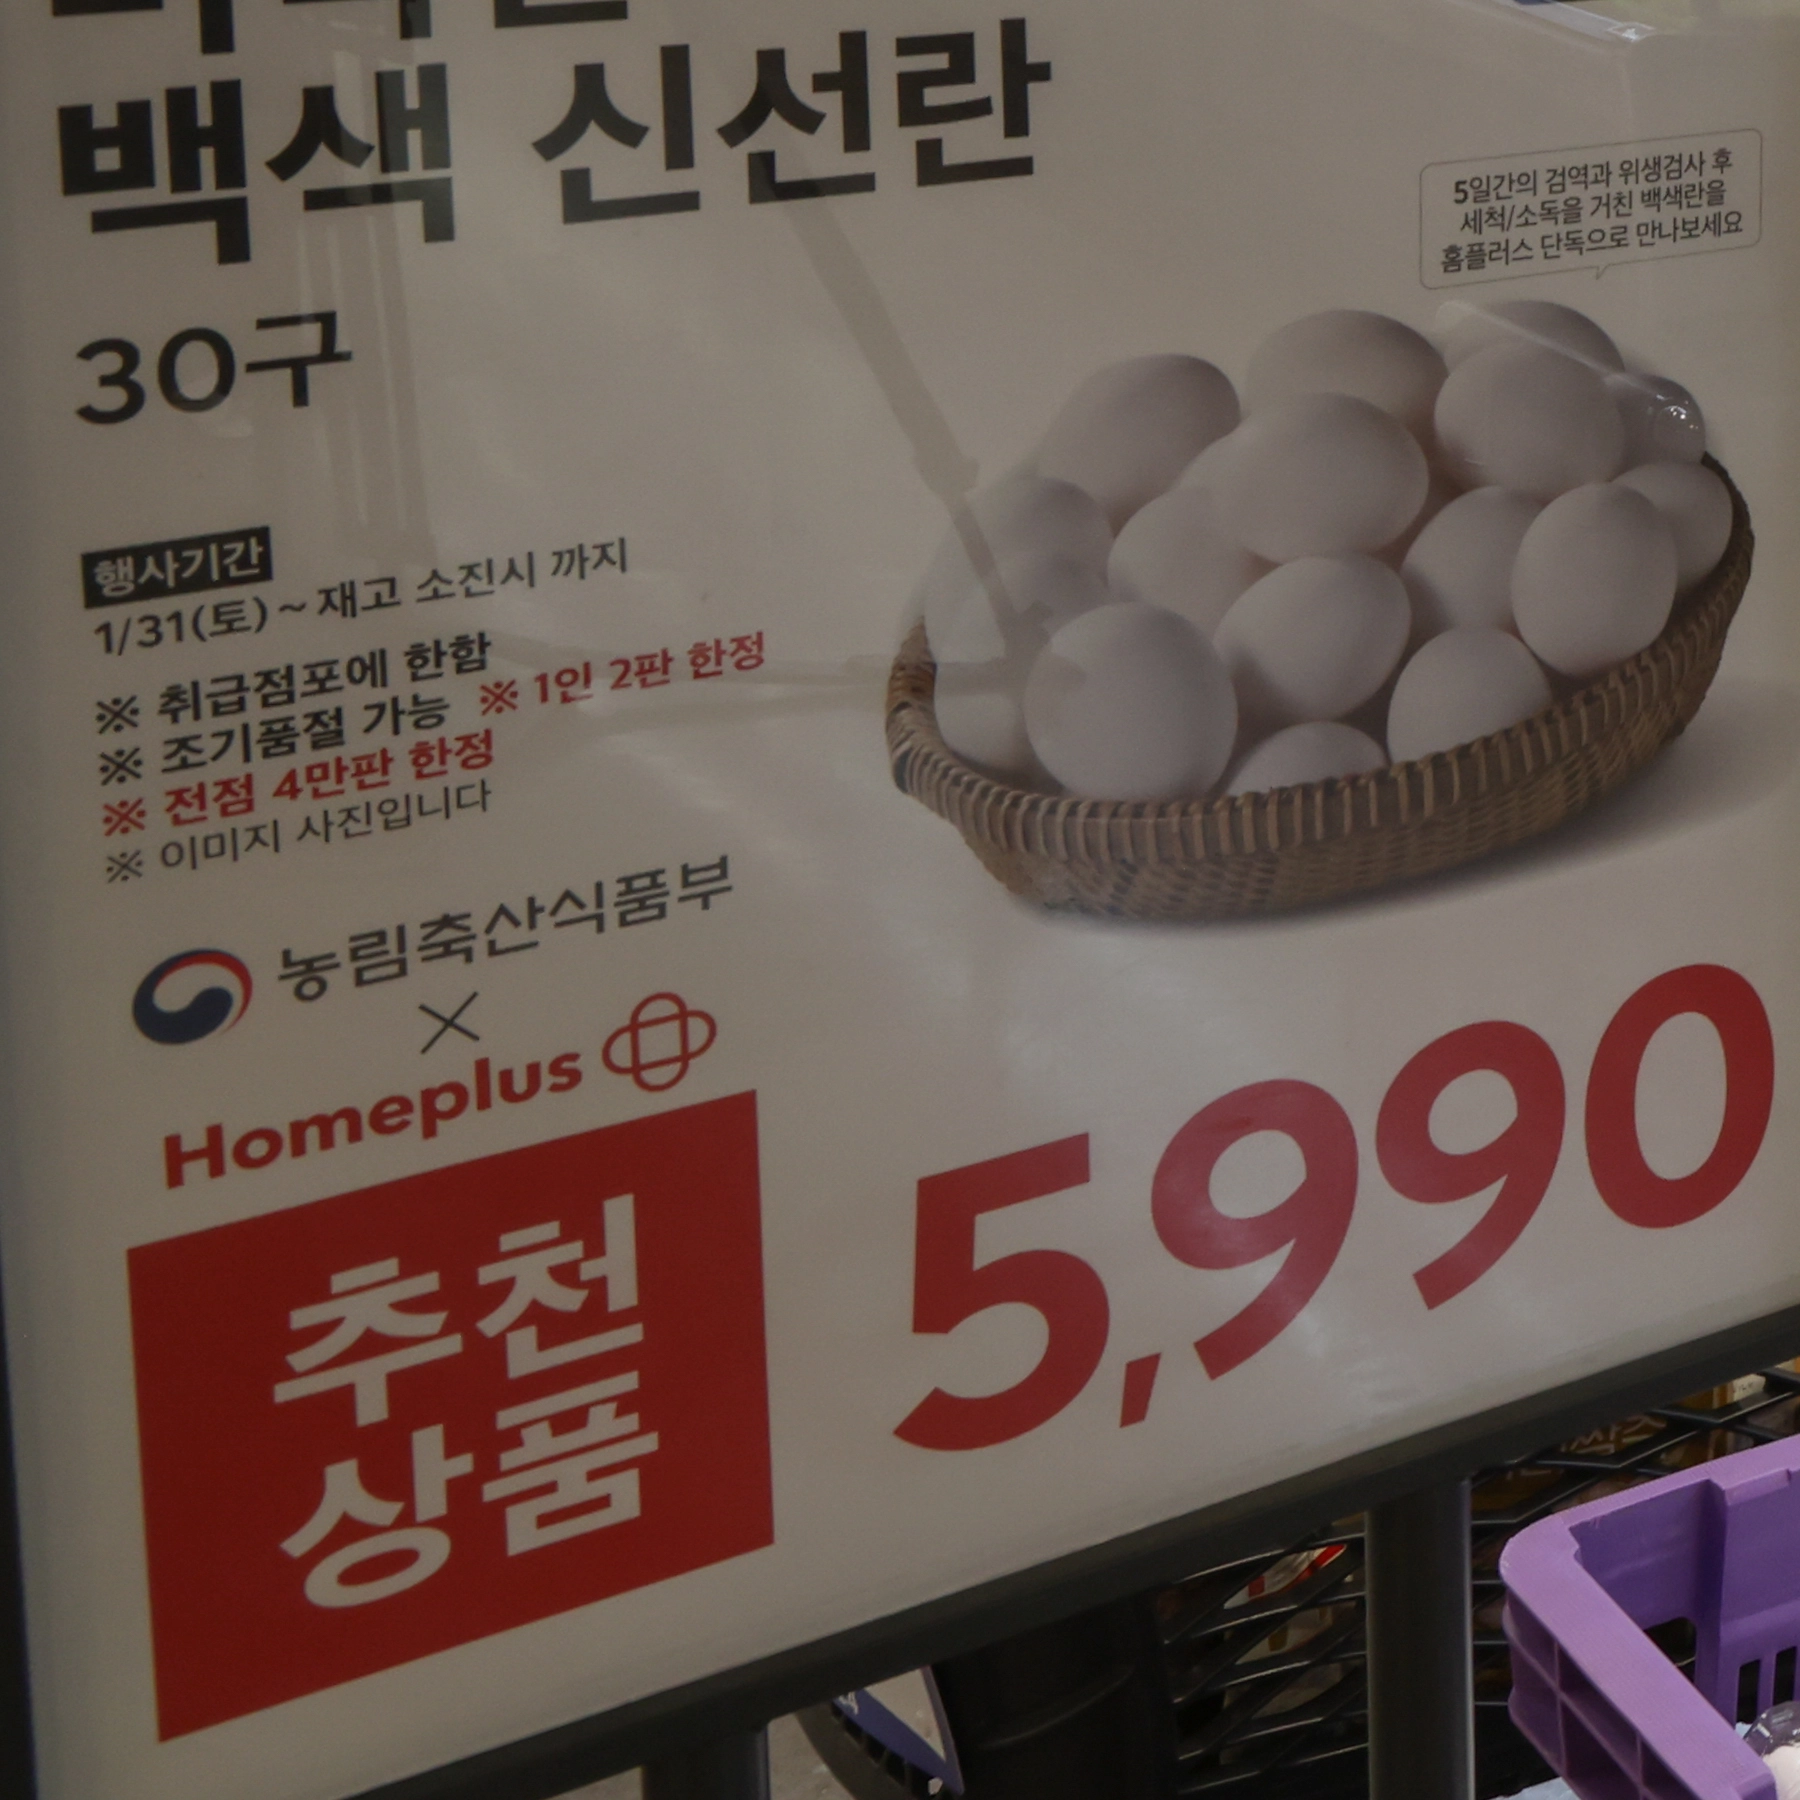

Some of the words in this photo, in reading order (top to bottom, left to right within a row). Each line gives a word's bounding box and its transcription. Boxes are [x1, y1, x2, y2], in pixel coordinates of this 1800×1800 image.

[57, 62, 455, 264] 백색
[531, 17, 1051, 224] 신선란
[1454, 169, 1538, 205] 5일간의
[1545, 161, 1612, 195] 검역과
[1619, 151, 1706, 187] 위생검사
[1712, 148, 1732, 175] 후
[1440, 238, 1533, 275] 홈플러스
[1541, 225, 1630, 261] 단독으로
[1636, 210, 1744, 247] 만나보세요
[1460, 196, 1583, 236] 세척/소독을
[1590, 190, 1633, 220] 거친
[1640, 179, 1727, 213] 백색란을
[75, 309, 353, 424] 30구
[95, 538, 263, 598] 행사기간
[318, 576, 401, 618] 재고
[415, 551, 537, 603] 소진시
[551, 536, 628, 582] 까지
[159, 648, 388, 725] 취급점포에
[404, 631, 491, 682] 한함
[533, 661, 594, 706] 1인
[610, 649, 674, 691] 2판
[688, 631, 767, 680] 한정
[161, 706, 346, 773] 조기품절
[364, 694, 450, 737] 가능
[165, 774, 255, 827] 전점
[273, 747, 394, 800] 4만판
[409, 729, 494, 781] 한정
[161, 820, 280, 870] 이미지
[297, 779, 491, 843] 사진입니다
[278, 856, 736, 1005] 농림축산식품부
[163, 1042, 582, 1189] Homeplus
[891, 963, 1775, 1453] 5,990
[272, 1193, 647, 1426] 추천
[279, 1371, 659, 1609] 상품
